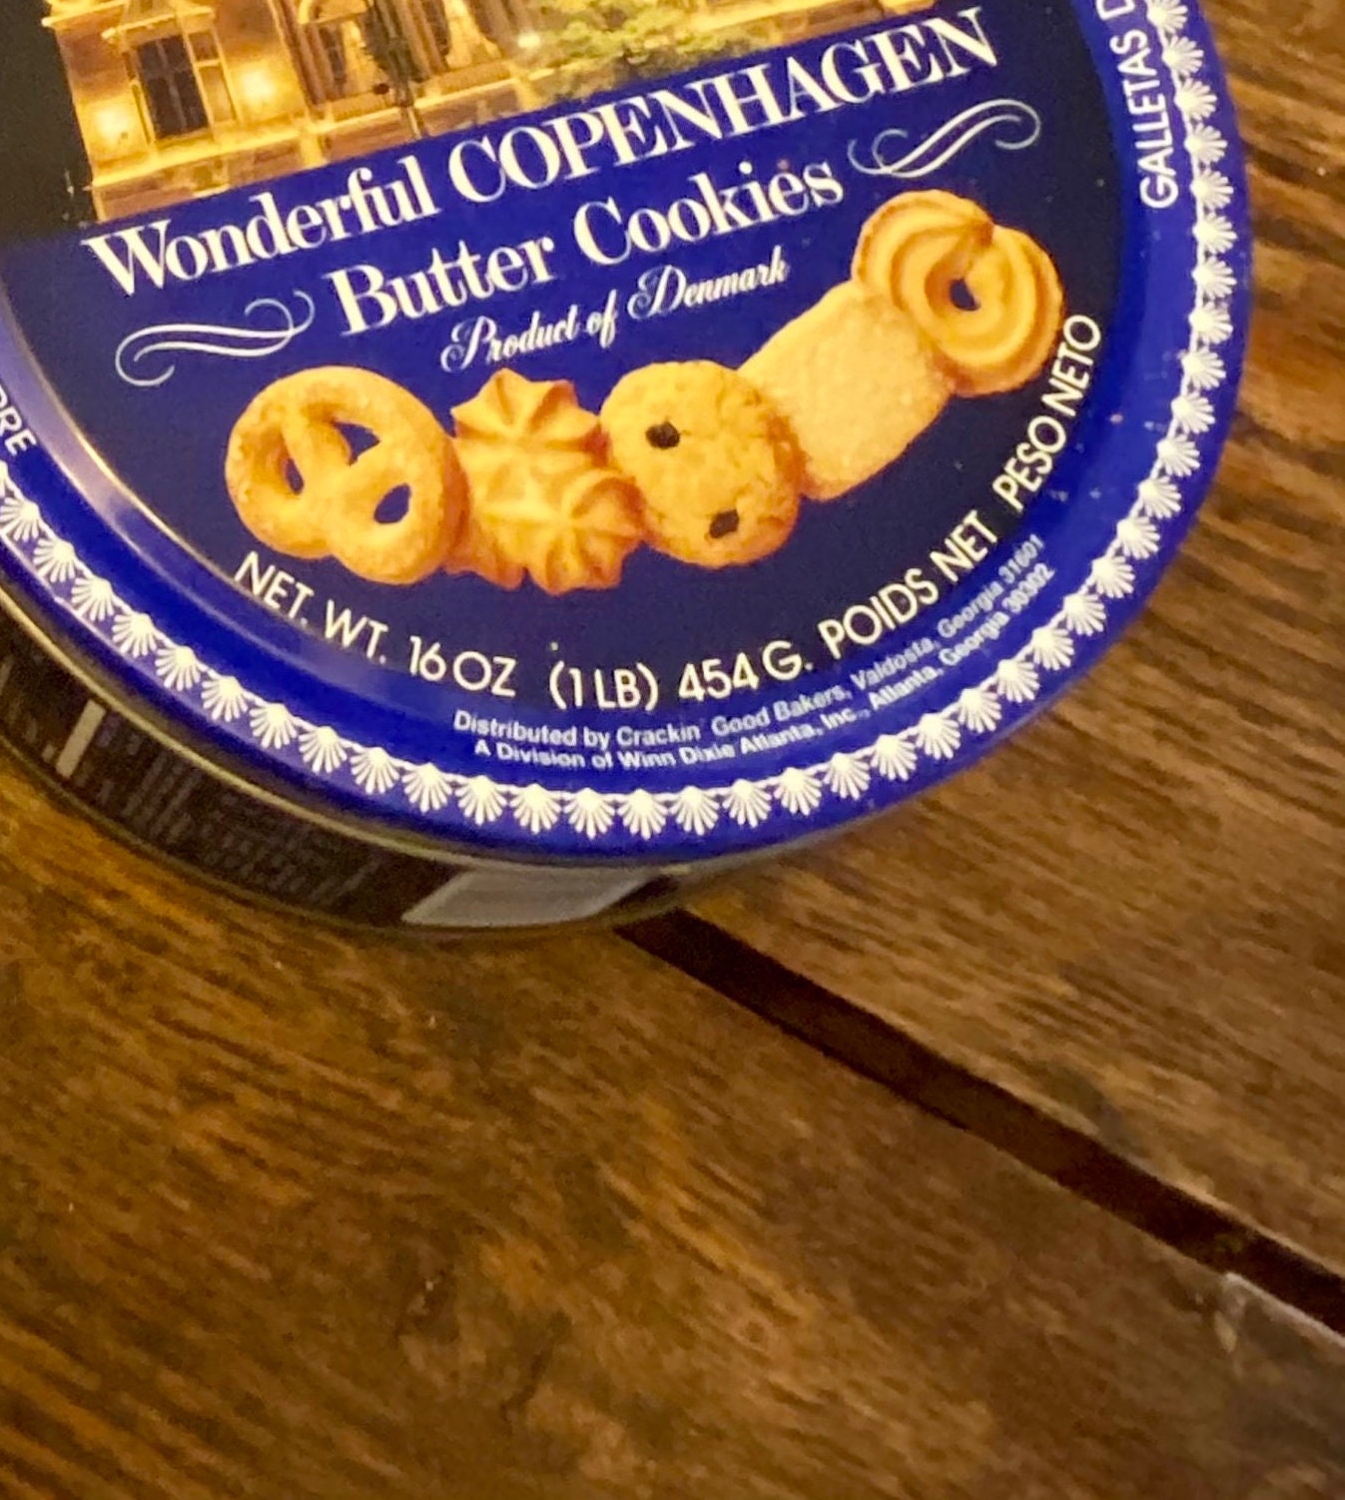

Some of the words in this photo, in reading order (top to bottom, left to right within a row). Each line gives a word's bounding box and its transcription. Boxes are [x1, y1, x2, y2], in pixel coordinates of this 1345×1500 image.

[81, 155, 439, 297] Wonderful
[447, 7, 1000, 204] COPENHAGEN
[1109, 29, 1179, 208] GALLETAS
[322, 235, 555, 336] Butter
[572, 158, 845, 267] Cookies
[440, 303, 578, 373] Product
[586, 288, 619, 348] of
[627, 245, 790, 320] Denmark
[234, 550, 310, 625] NET.
[323, 599, 388, 665] WT.
[817, 568, 939, 660] POIDS
[929, 510, 998, 582] NET
[991, 414, 1067, 512] PESO
[1041, 314, 1102, 417] NETO
[453, 708, 578, 747] Distributed
[583, 726, 611, 751] by
[711, 706, 771, 737] Good
[937, 580, 1005, 638] Georgia
[998, 533, 1045, 584] 31601
[474, 738, 492, 757] A
[496, 742, 586, 768] Division
[591, 751, 614, 770] of
[617, 750, 677, 770] Winn
[679, 743, 736, 765] Dixie
[938, 610, 1010, 666] Georgia
